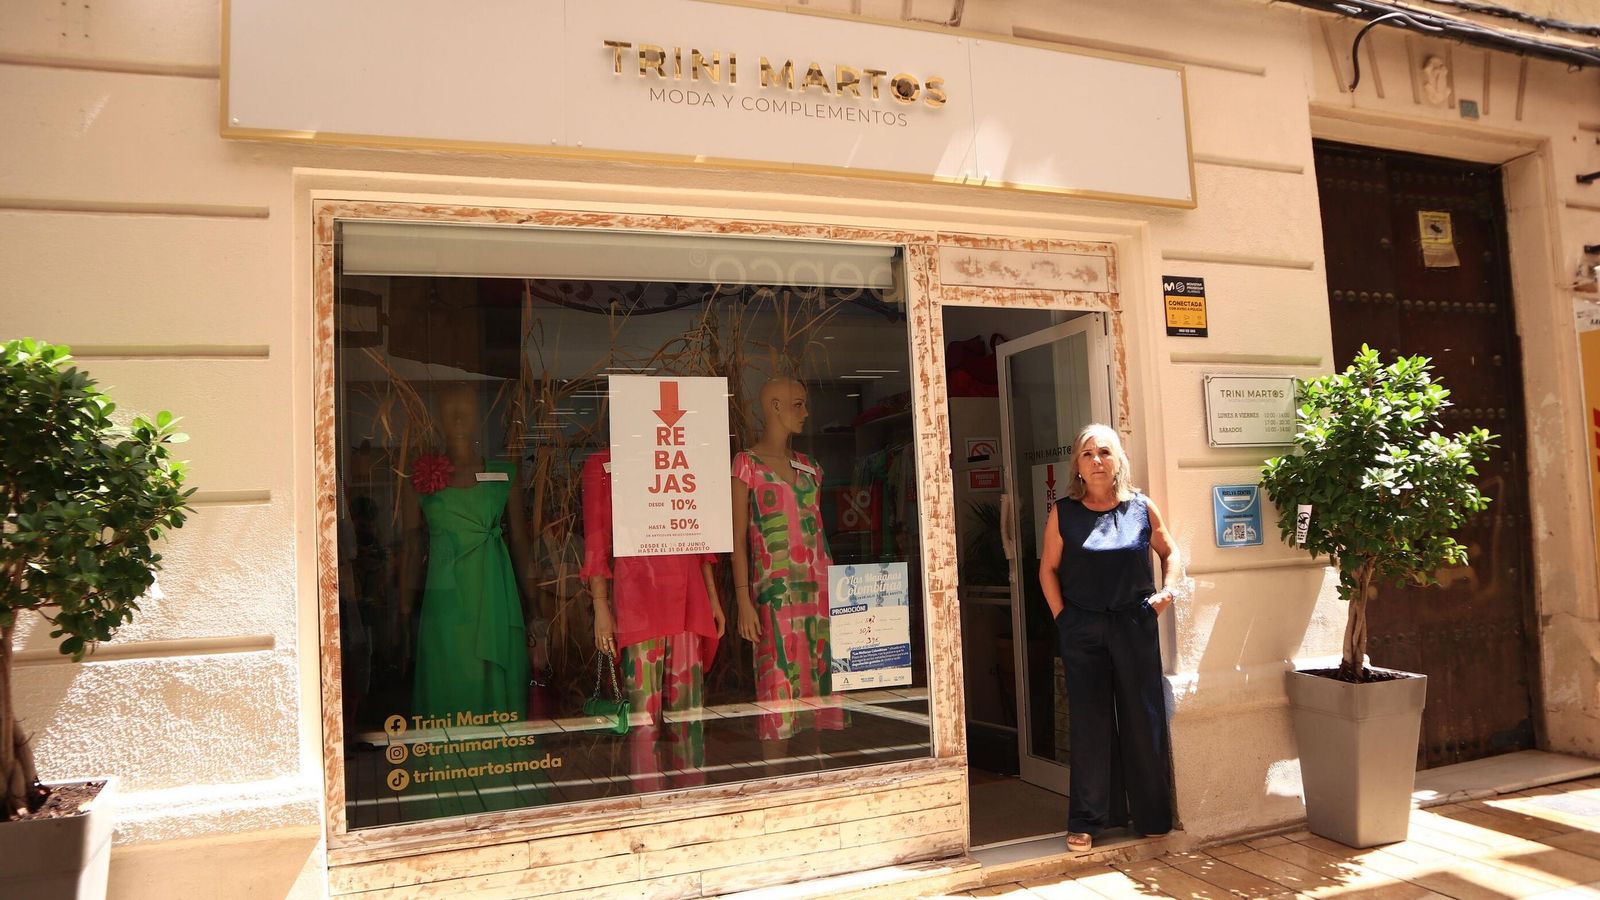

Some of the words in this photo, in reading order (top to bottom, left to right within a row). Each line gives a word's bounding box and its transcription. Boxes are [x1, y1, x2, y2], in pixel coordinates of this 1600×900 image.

[603, 40, 736, 84] TRINI
[758, 55, 947, 109] MARTOS
[649, 87, 715, 108] MODA
[721, 95, 734, 108] Y
[741, 96, 908, 127] COMPLEMENTOS
[1220, 389, 1245, 398] TRINI
[1247, 389, 1285, 398] MARTOS
[656, 426, 686, 446] RE
[654, 450, 690, 470] BA
[1025, 450, 1044, 461] TRINI
[1045, 445, 1072, 458] MARTO
[648, 473, 697, 494] JAS
[671, 498, 697, 511] 10%
[1046, 489, 1057, 500] RE
[670, 518, 700, 530] 50%
[412, 712, 451, 732] Trini
[456, 710, 518, 727] Martos
[412, 735, 535, 757] @trinimartoss
[413, 753, 562, 784] trinimartosmoda
